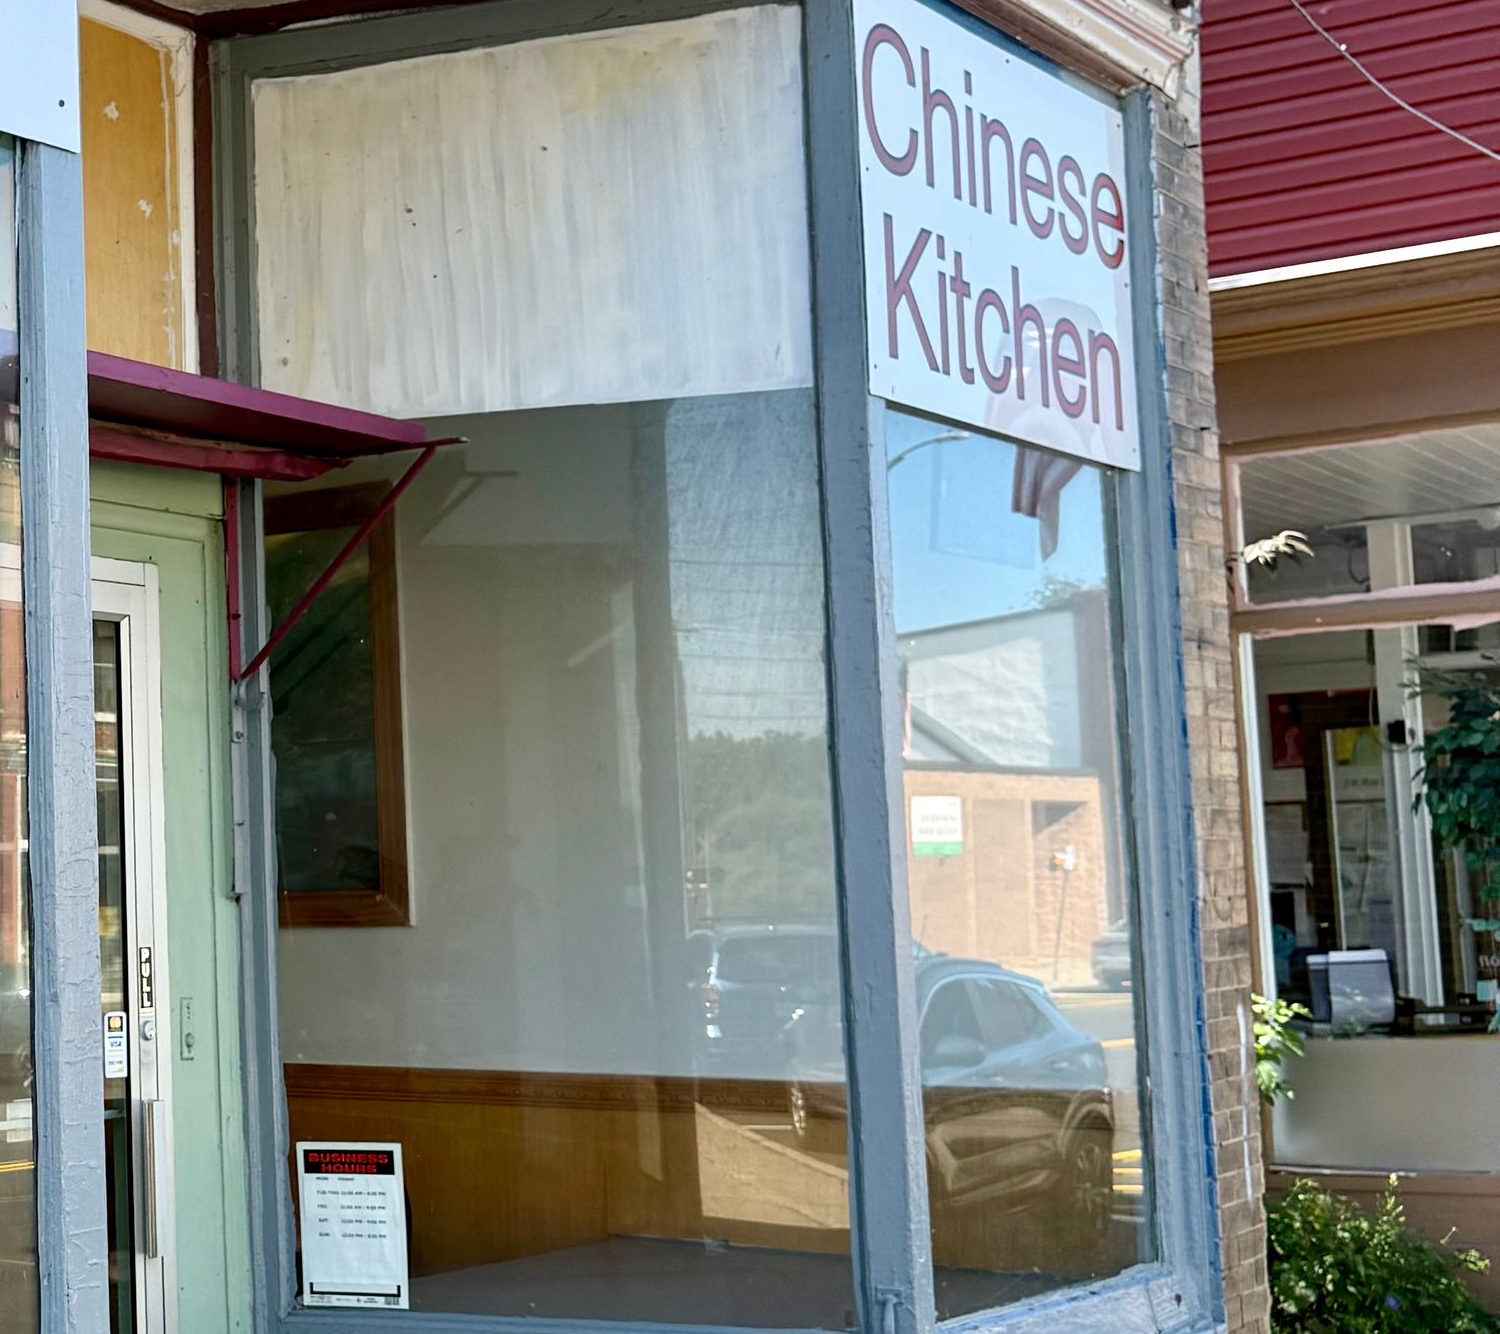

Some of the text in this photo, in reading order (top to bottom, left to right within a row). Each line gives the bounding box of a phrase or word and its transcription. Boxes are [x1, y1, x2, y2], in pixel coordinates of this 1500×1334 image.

[861, 22, 1125, 269] Chinese
[882, 211, 1125, 432] Kitchen
[140, 947, 151, 1008] PULL
[308, 1152, 389, 1164] BUSINESS
[321, 1163, 377, 1173] HOURS
